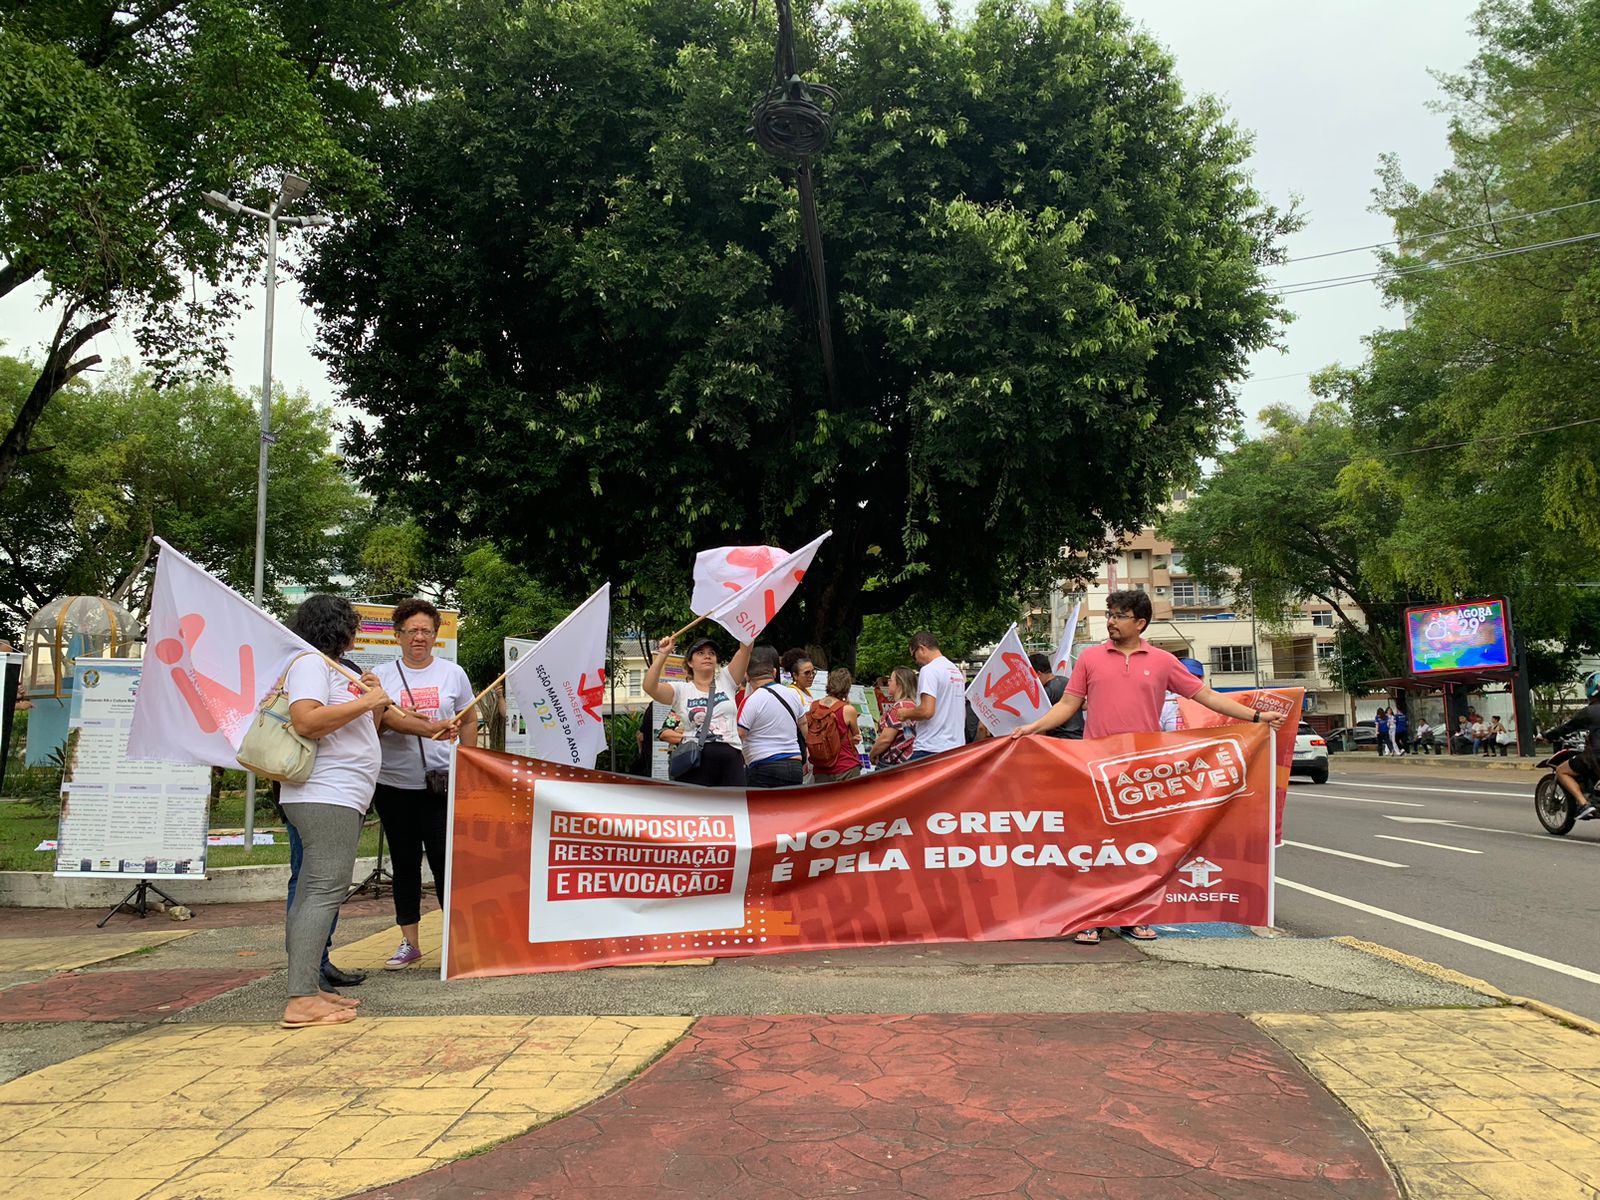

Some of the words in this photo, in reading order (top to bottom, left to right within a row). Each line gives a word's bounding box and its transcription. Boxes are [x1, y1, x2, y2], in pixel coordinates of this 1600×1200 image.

[1457, 607, 1492, 619] AGORA
[533, 698, 557, 730] 2022
[536, 664, 550, 687] SEÇÃO
[546, 686, 568, 723] MANAUS
[562, 724, 571, 735] 30
[567, 737, 580, 764] ANOS
[563, 680, 585, 726] SINASEFE
[1259, 695, 1284, 708] AGORA
[1116, 757, 1210, 787] AGORA
[1216, 747, 1234, 767] É
[1119, 766, 1239, 805] GREVE!
[554, 815, 734, 841] RECOMPOSIÇÃO,
[776, 817, 913, 854] NOSSA
[926, 811, 1064, 834] GREVE
[555, 844, 729, 867] REESTRUTURAÇÃO
[771, 858, 794, 882] É
[808, 848, 910, 877] PELA
[924, 838, 1158, 872] EDUCAÇÃO
[557, 873, 570, 894] E
[577, 869, 725, 896] REVOGAÇÃO:
[1166, 892, 1240, 903] SINASEFE
